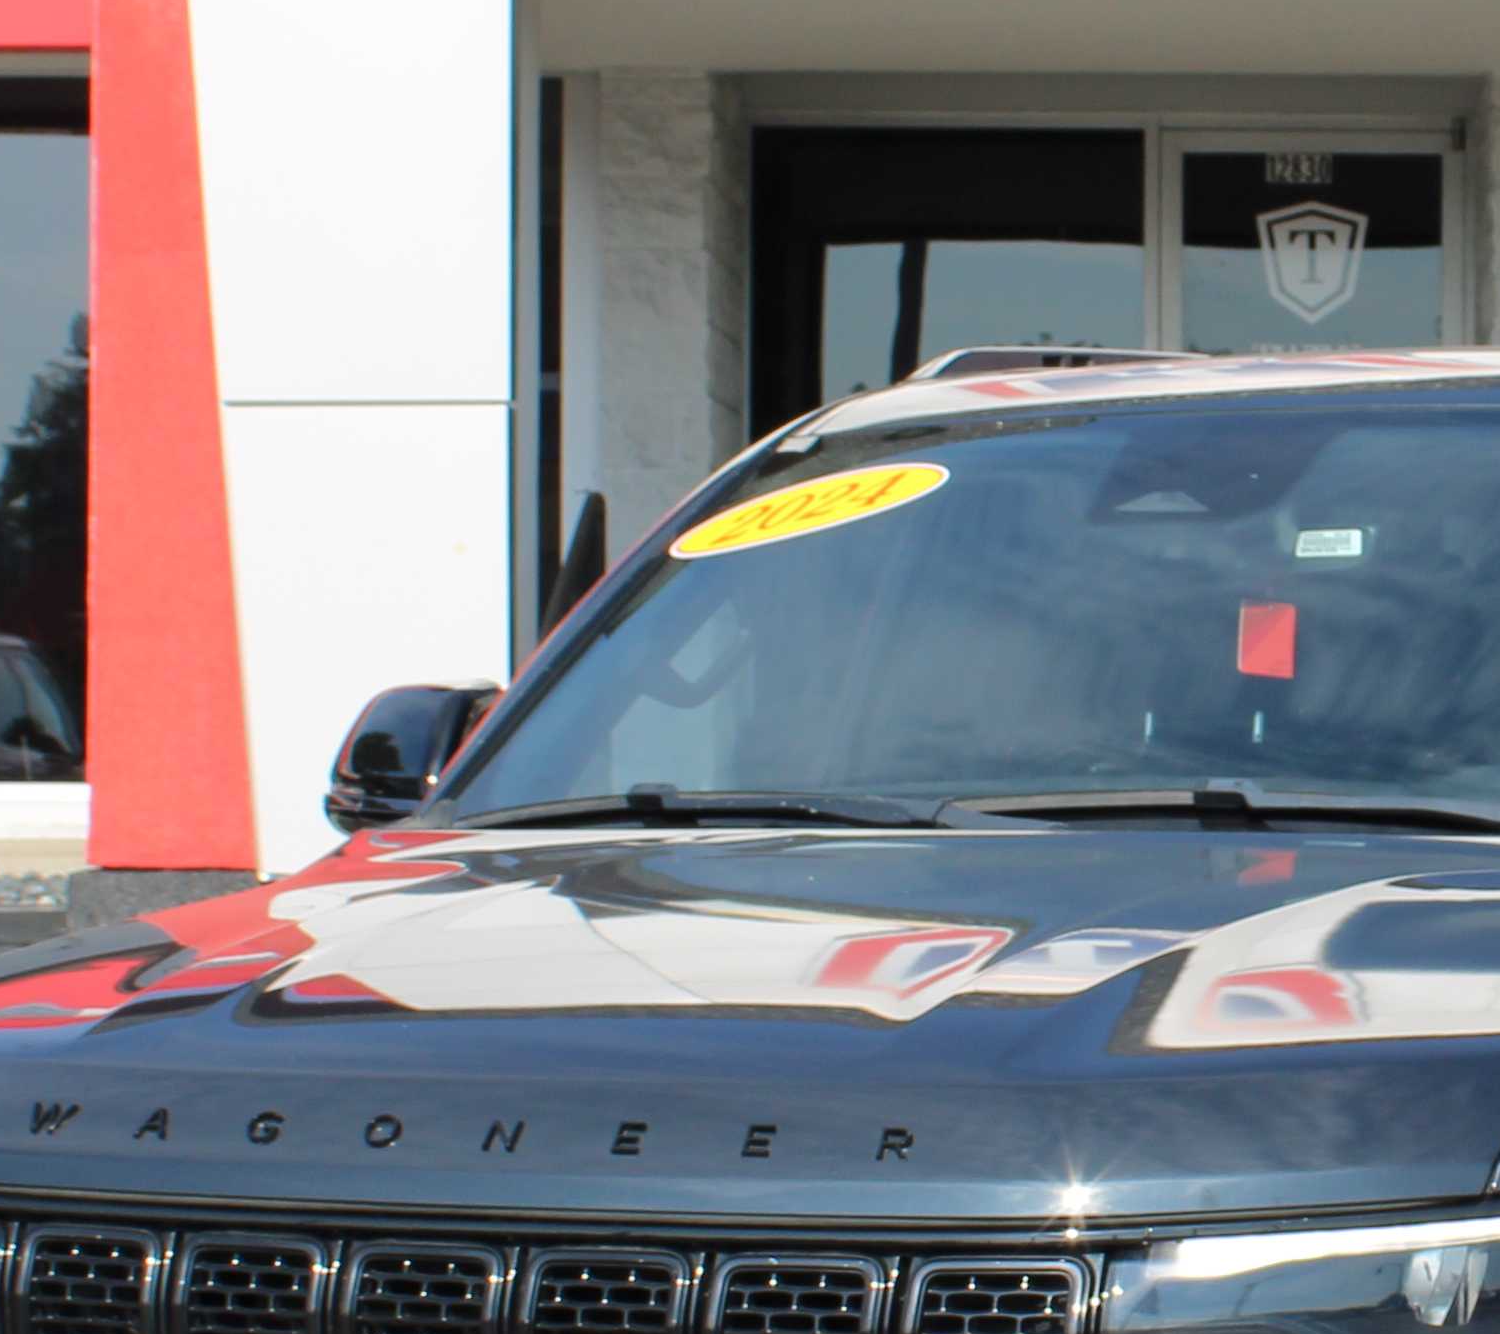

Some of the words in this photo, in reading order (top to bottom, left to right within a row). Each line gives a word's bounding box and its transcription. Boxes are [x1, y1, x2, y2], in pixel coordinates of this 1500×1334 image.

[1288, 229, 1336, 285] T
[709, 471, 907, 546] 2024
[29, 1101, 917, 1163] WAGONEER
